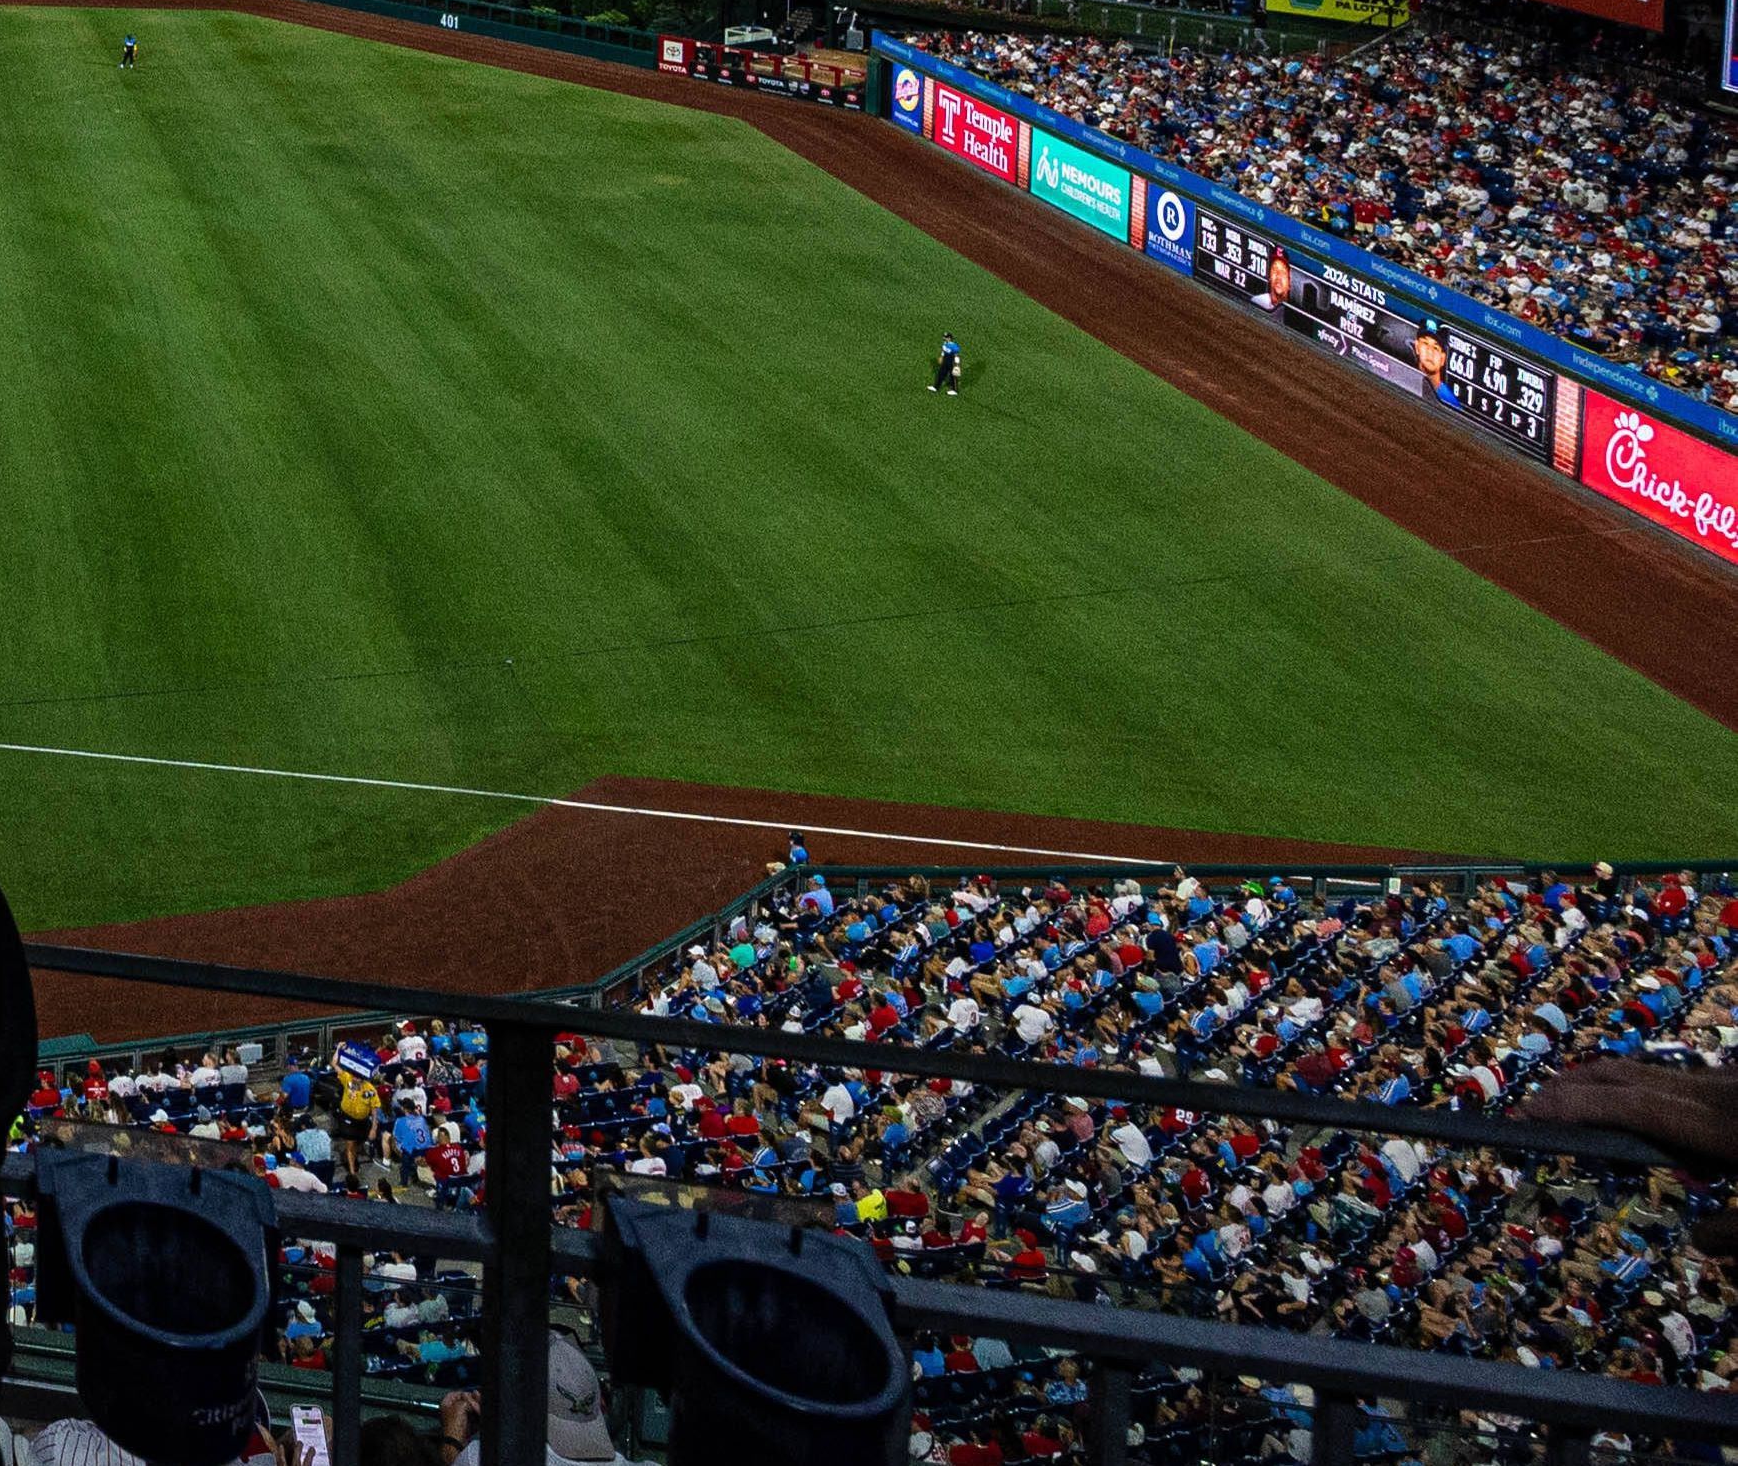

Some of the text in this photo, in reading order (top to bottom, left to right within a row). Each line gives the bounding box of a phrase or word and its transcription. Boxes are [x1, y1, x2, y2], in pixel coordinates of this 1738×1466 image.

[1335, 0, 1352, 10] PA
[658, 62, 688, 74] TOYOTA
[758, 77, 785, 87] TOYOTA
[964, 100, 1013, 144] Temple
[963, 130, 1009, 174] Health
[1061, 162, 1122, 207] NEMOURS
[1165, 207, 1177, 226] R
[1148, 230, 1192, 261] ROTHMAN
[1201, 231, 1267, 277] 133 .353 .318
[1301, 229, 1331, 251] ibx.com
[1214, 259, 1231, 280] WAR
[1323, 265, 1386, 305] 2024 STATS
[1371, 258, 1427, 293] Independence
[1330, 291, 1376, 325] RAMÍREZ
[1340, 316, 1364, 339] RUIZ
[1484, 313, 1522, 338] ibx.com
[1318, 328, 1389, 372] xfinity Pitch Speed
[1489, 354, 1503, 371] FIP
[1449, 351, 1543, 414] 66.0 4.90 .329
[1572, 353, 1645, 393] Independence
[1494, 400, 1536, 438] 2 3
[450, 1157, 460, 1173] 3
